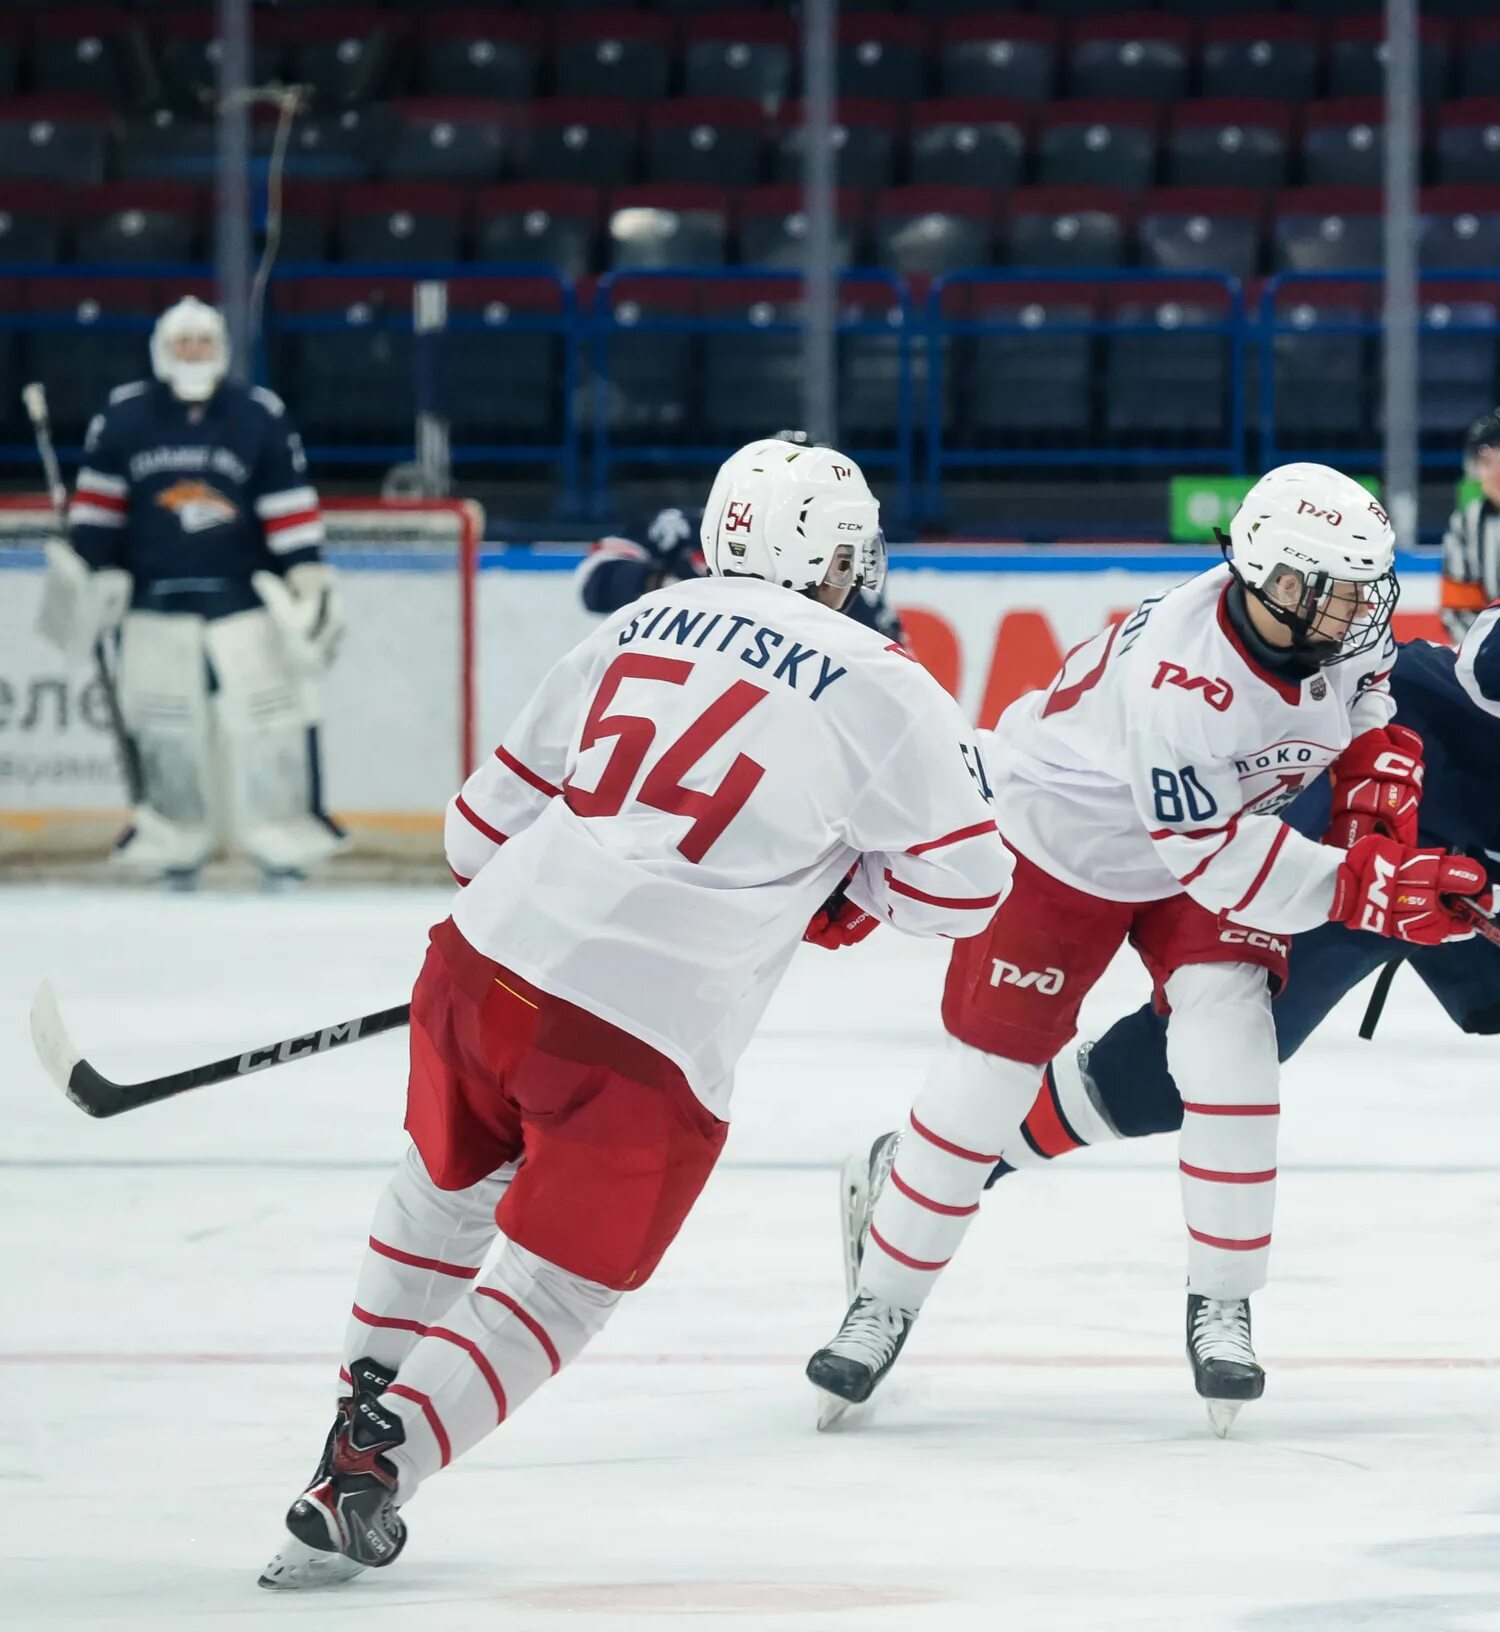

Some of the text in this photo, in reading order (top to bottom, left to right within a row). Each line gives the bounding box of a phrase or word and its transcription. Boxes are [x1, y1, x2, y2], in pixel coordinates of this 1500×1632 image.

[725, 501, 753, 533] 54
[837, 521, 864, 531] CCM
[1283, 546, 1320, 565] CCM
[618, 606, 848, 701] SINITSKY
[563, 652, 769, 864] 54
[1152, 765, 1218, 822] 80
[1360, 854, 1397, 933] CM
[1219, 929, 1287, 958] CCM
[238, 1017, 363, 1075] CCM
[363, 1370, 389, 1387] CC
[359, 1403, 393, 1431] CCM
[366, 1529, 386, 1555] CCM
